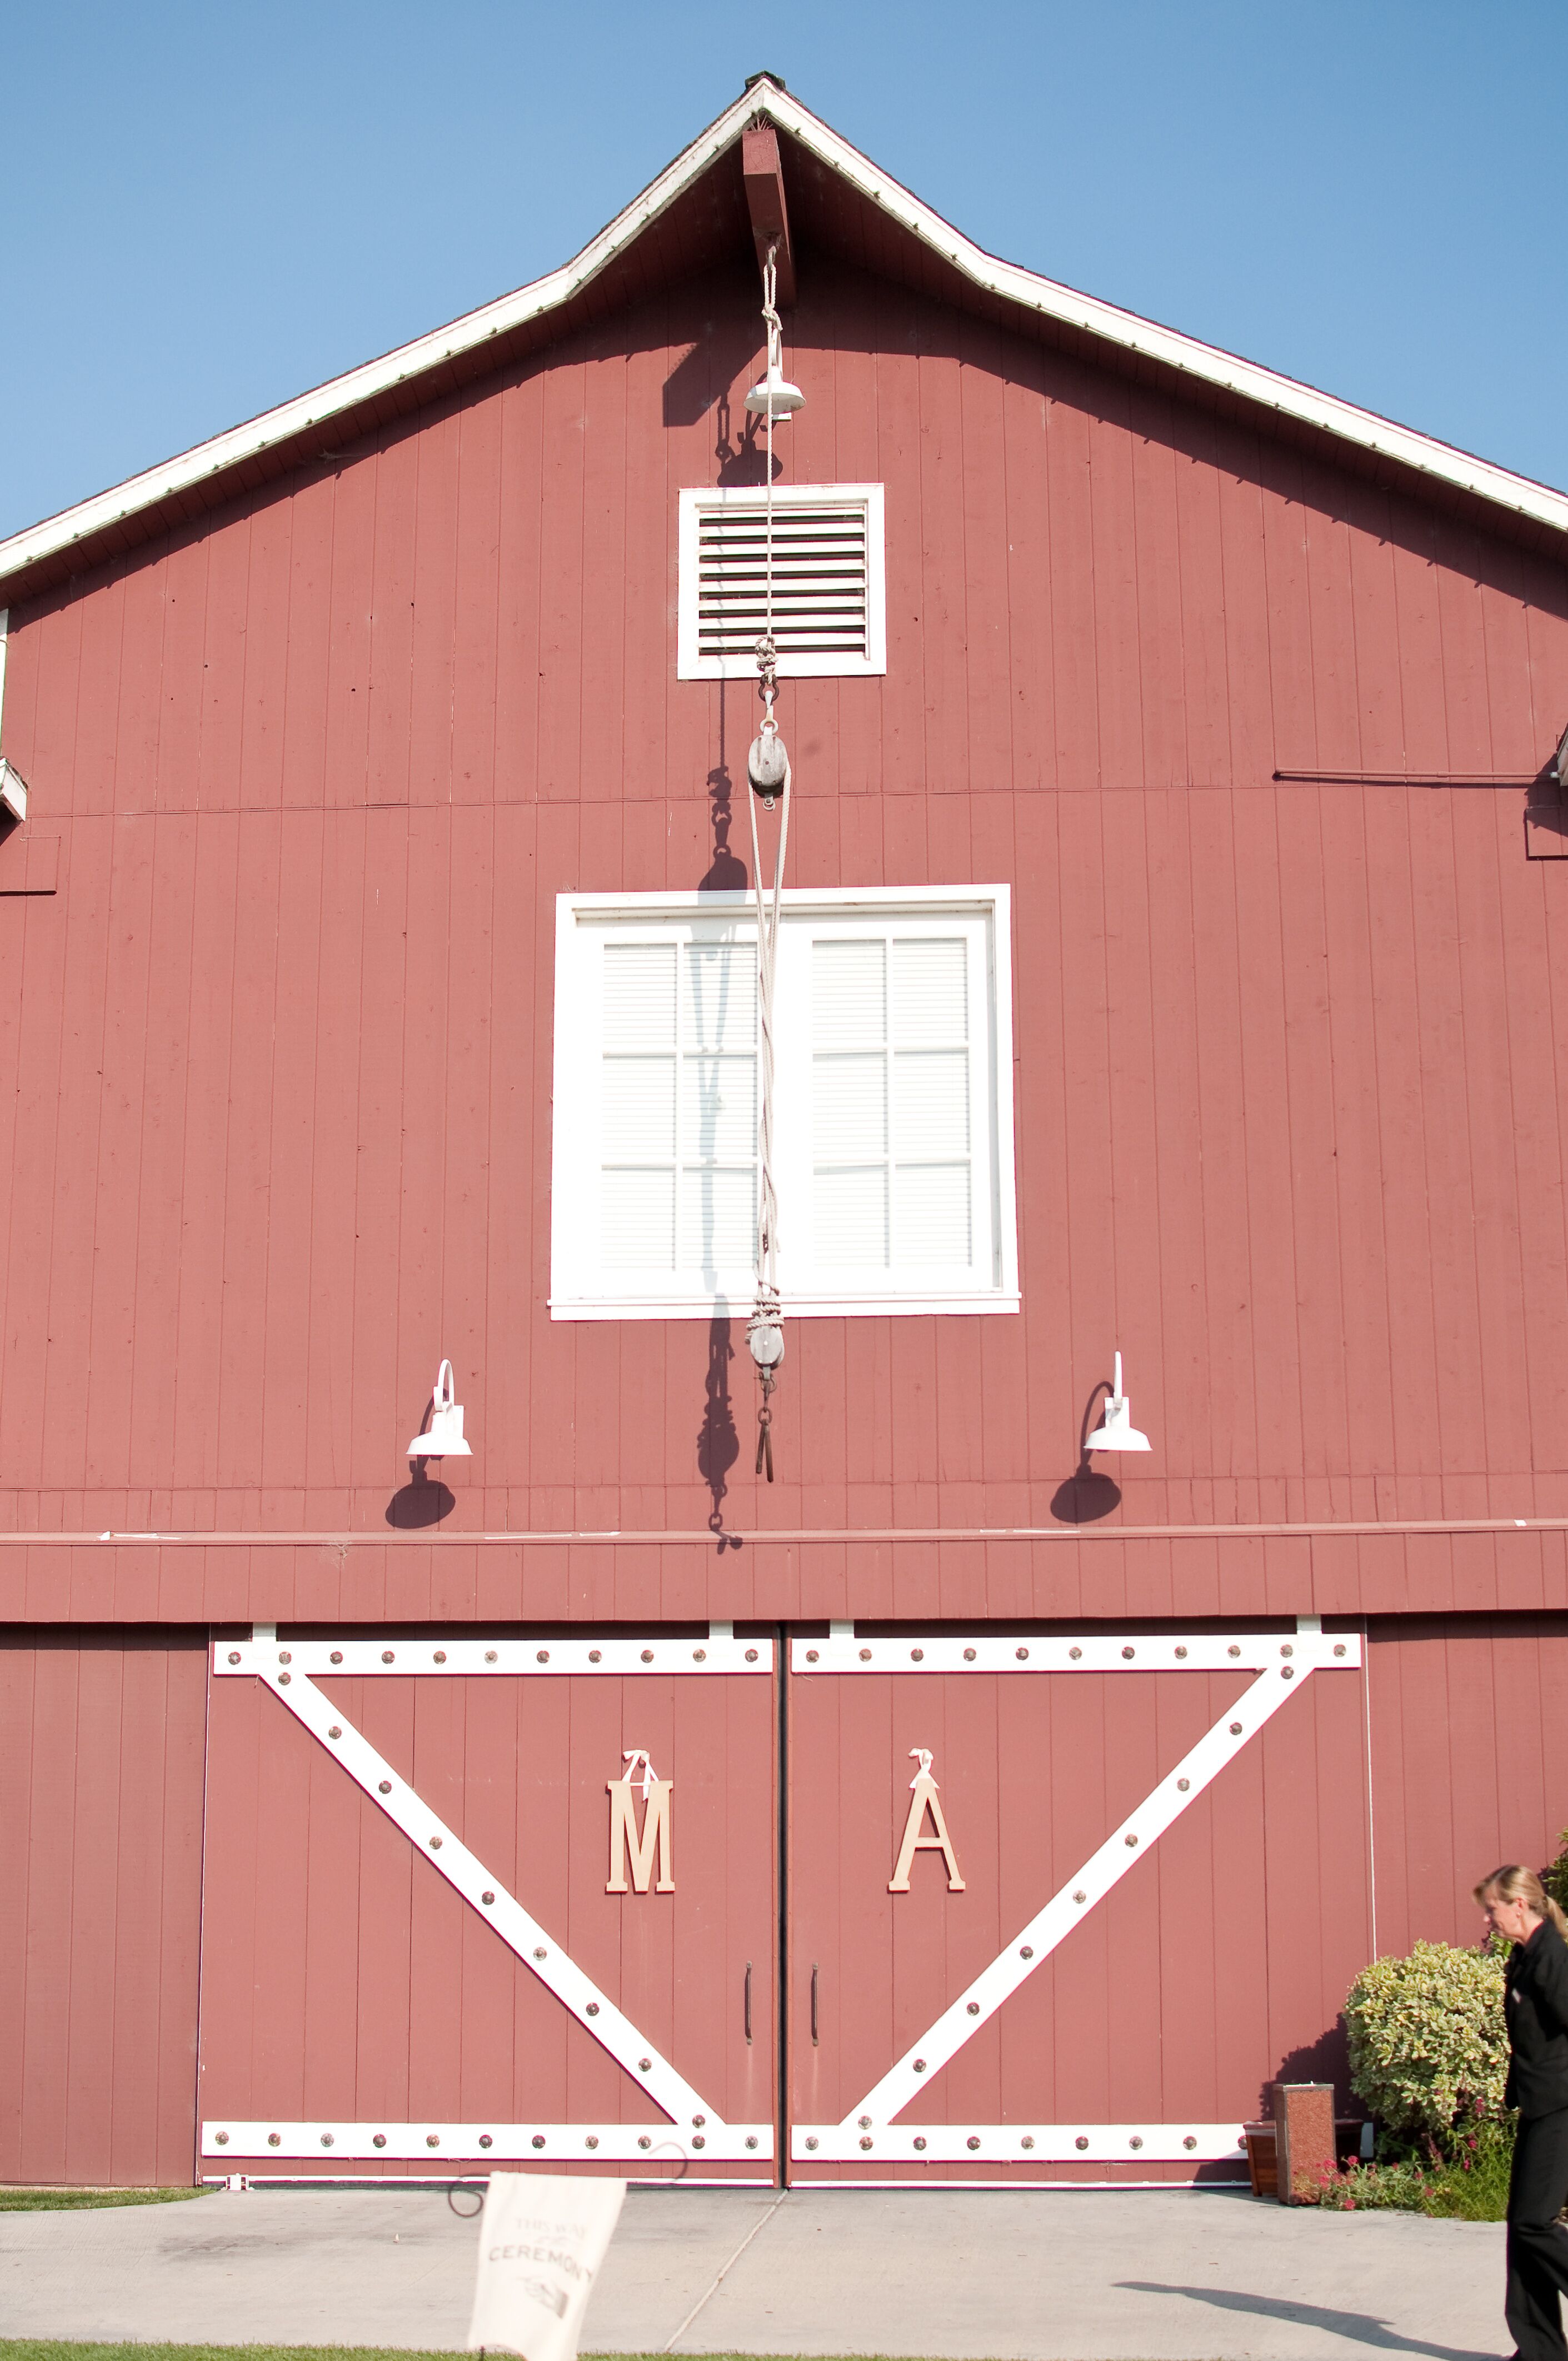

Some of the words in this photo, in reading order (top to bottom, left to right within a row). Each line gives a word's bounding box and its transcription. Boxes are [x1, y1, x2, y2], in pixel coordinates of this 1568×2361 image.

[606, 1780, 675, 1891] M
[888, 1778, 966, 1891] A
[489, 2245, 593, 2282] CEREMONY
[516, 2217, 550, 2232] THIS
[555, 2223, 587, 2240] WAY
